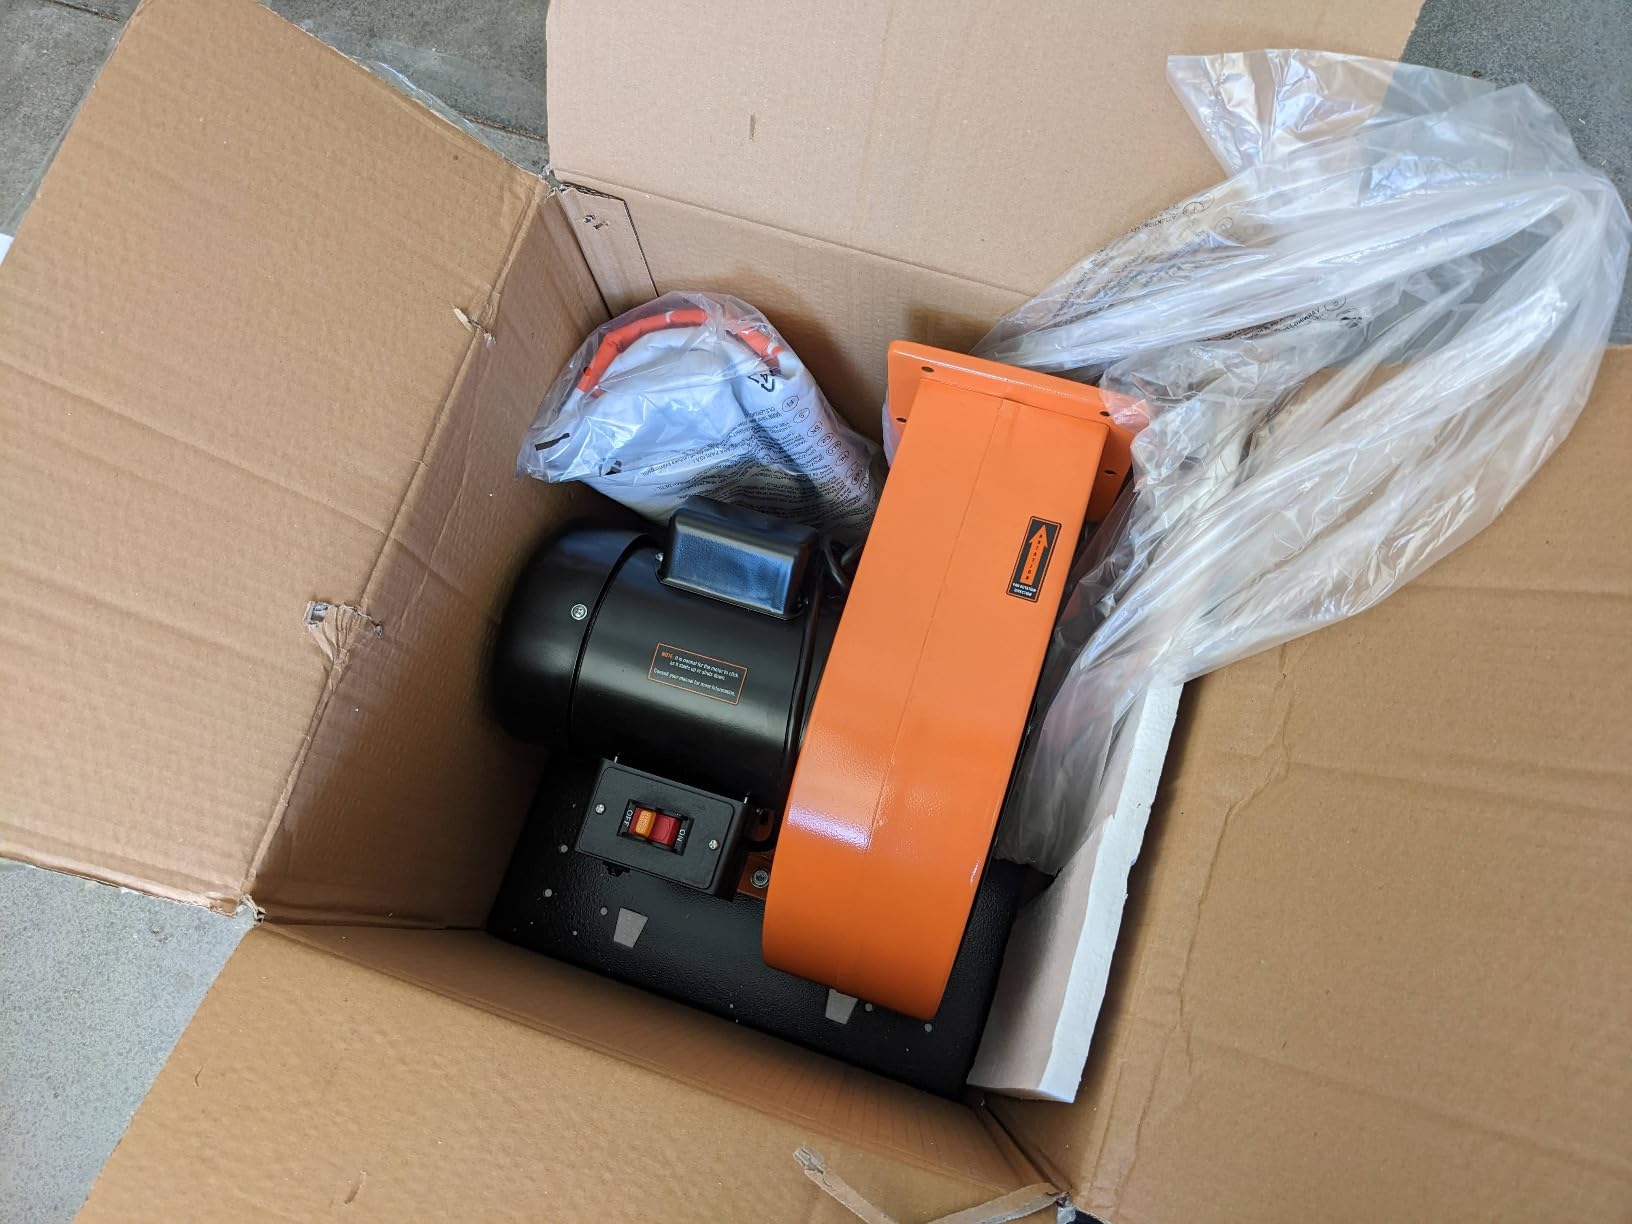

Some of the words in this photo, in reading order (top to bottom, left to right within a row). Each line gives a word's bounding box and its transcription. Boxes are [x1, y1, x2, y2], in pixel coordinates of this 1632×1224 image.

[786, 400, 794, 408] FI
[811, 424, 820, 434] SK
[682, 657, 697, 666] normal
[653, 667, 669, 676] Consult
[668, 672, 679, 680] your
[678, 675, 693, 683] manual
[711, 685, 736, 696] information.
[624, 810, 633, 826] OFF
[676, 829, 686, 842] ON
